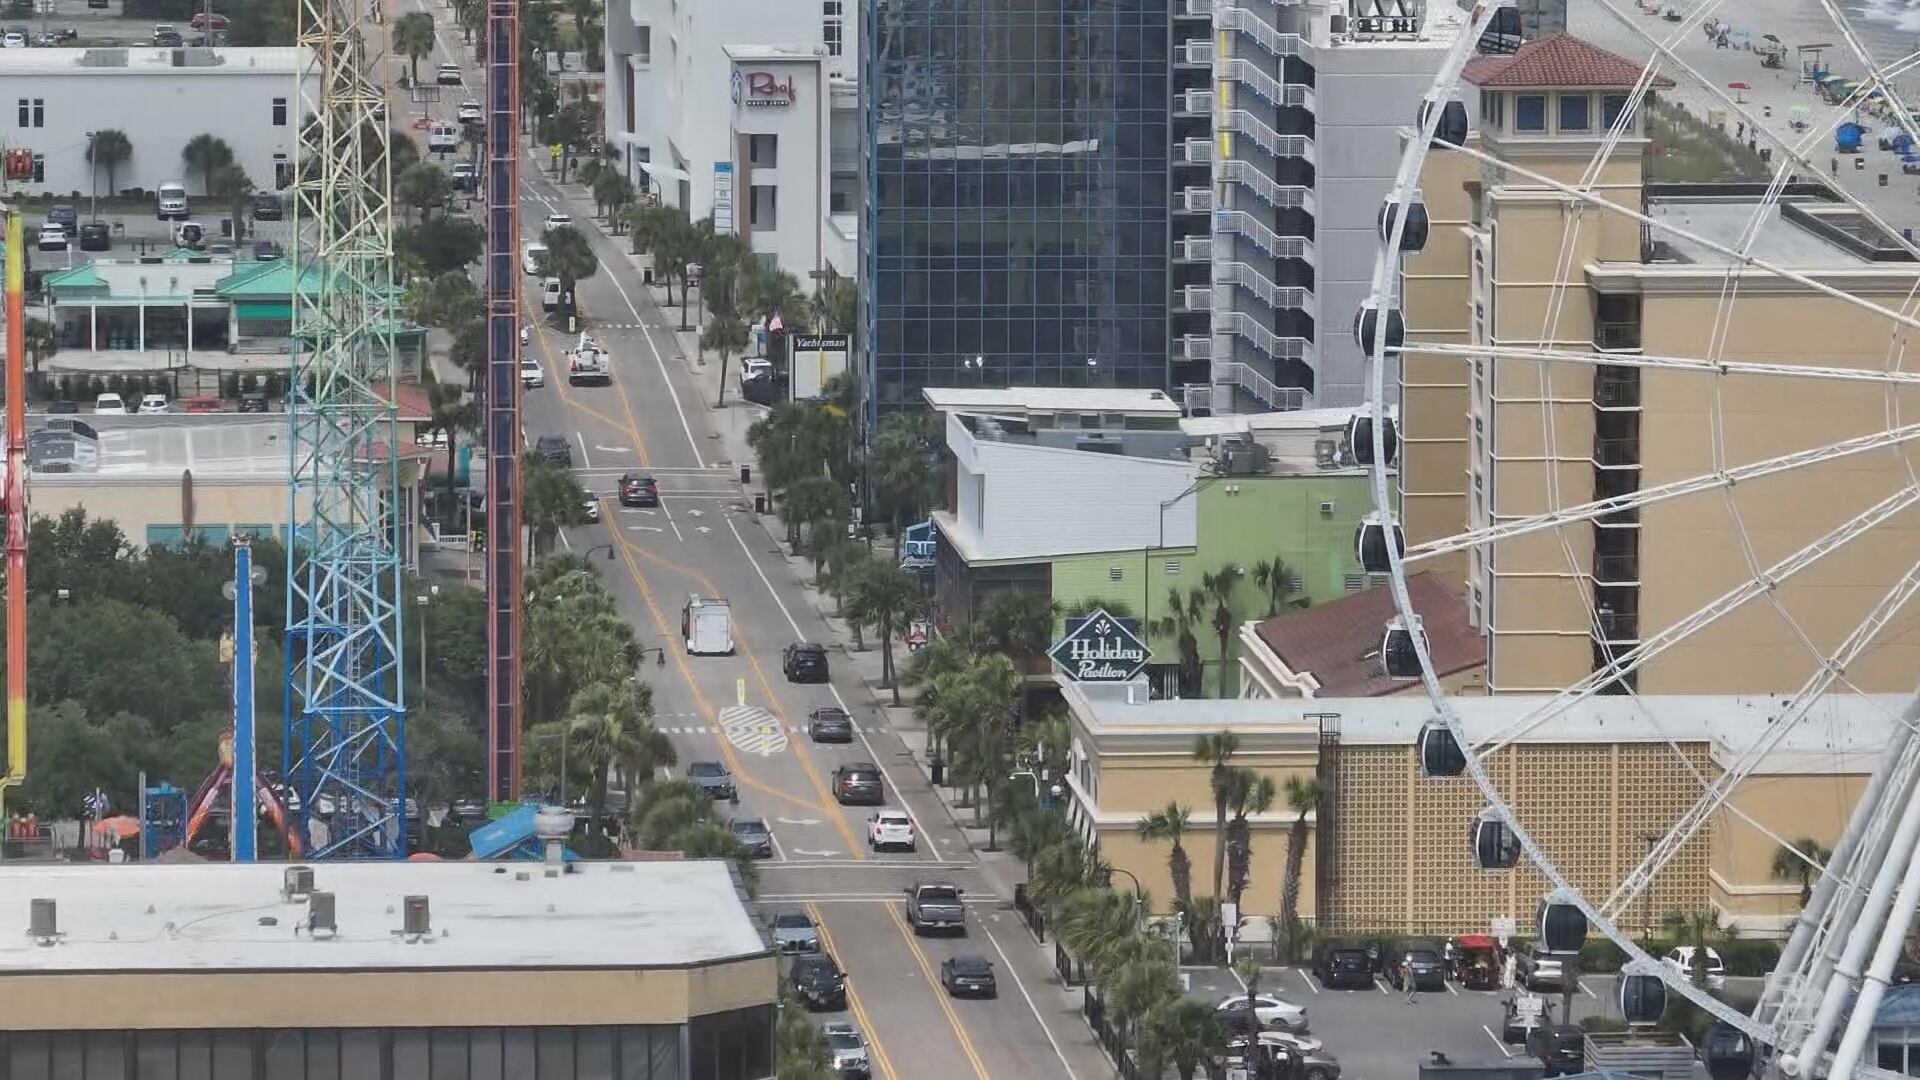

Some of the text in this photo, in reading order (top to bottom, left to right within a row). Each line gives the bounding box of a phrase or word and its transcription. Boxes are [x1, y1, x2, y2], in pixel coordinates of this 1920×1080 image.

[796, 337, 845, 348] Yachtsman
[1070, 637, 1143, 663] Holiday
[1078, 660, 1127, 678] Pavilion
